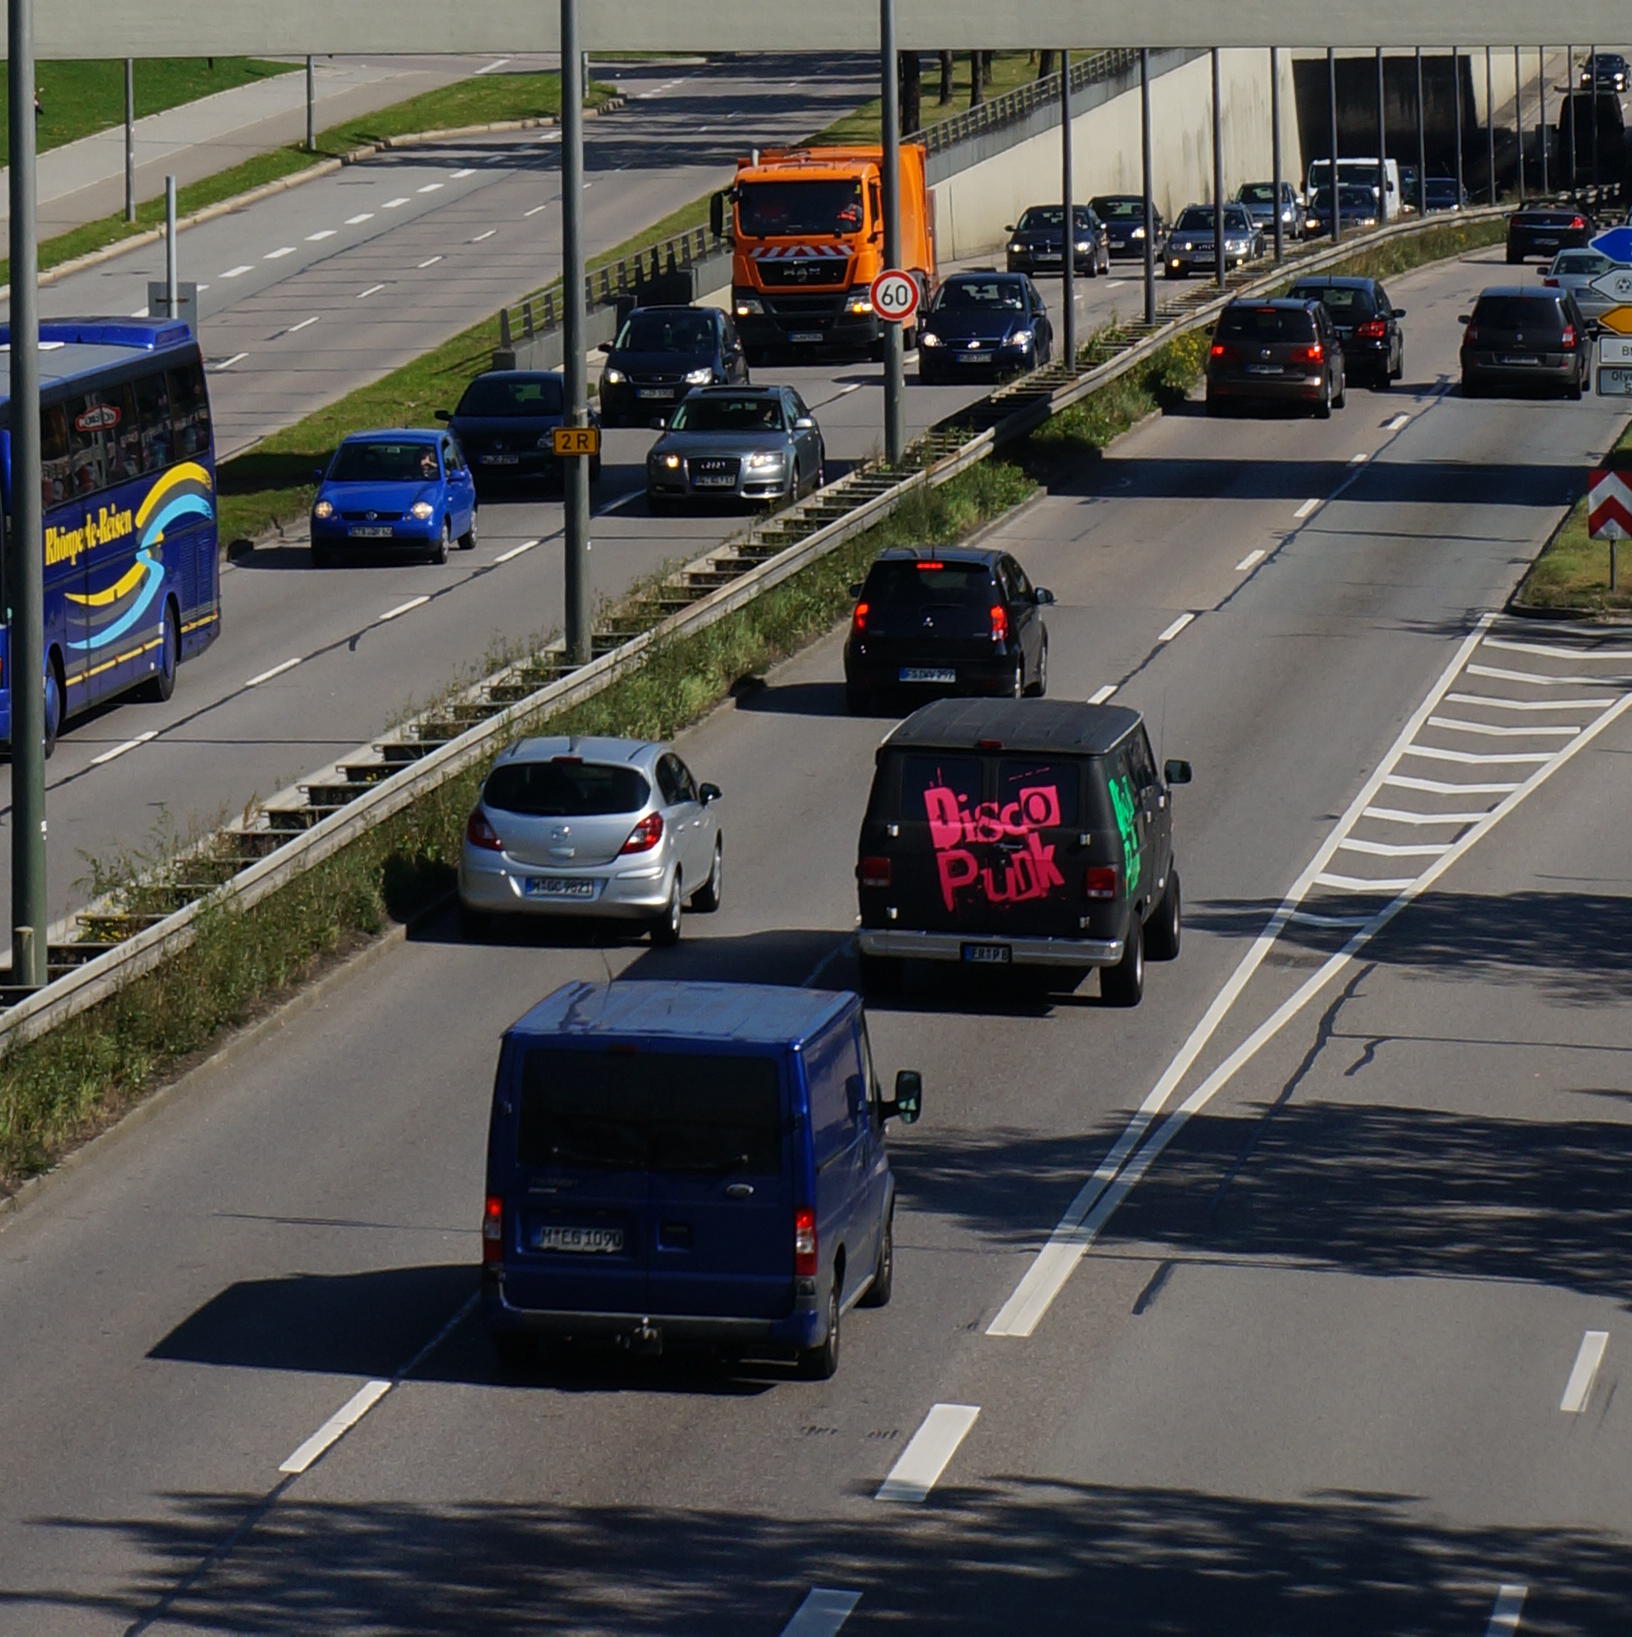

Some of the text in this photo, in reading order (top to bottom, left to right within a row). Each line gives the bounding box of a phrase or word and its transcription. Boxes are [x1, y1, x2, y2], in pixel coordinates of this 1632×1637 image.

[881, 283, 908, 306] 60
[1611, 370, 1632, 383] Oly
[924, 784, 1061, 851] Disco
[936, 831, 1065, 913] Punk
